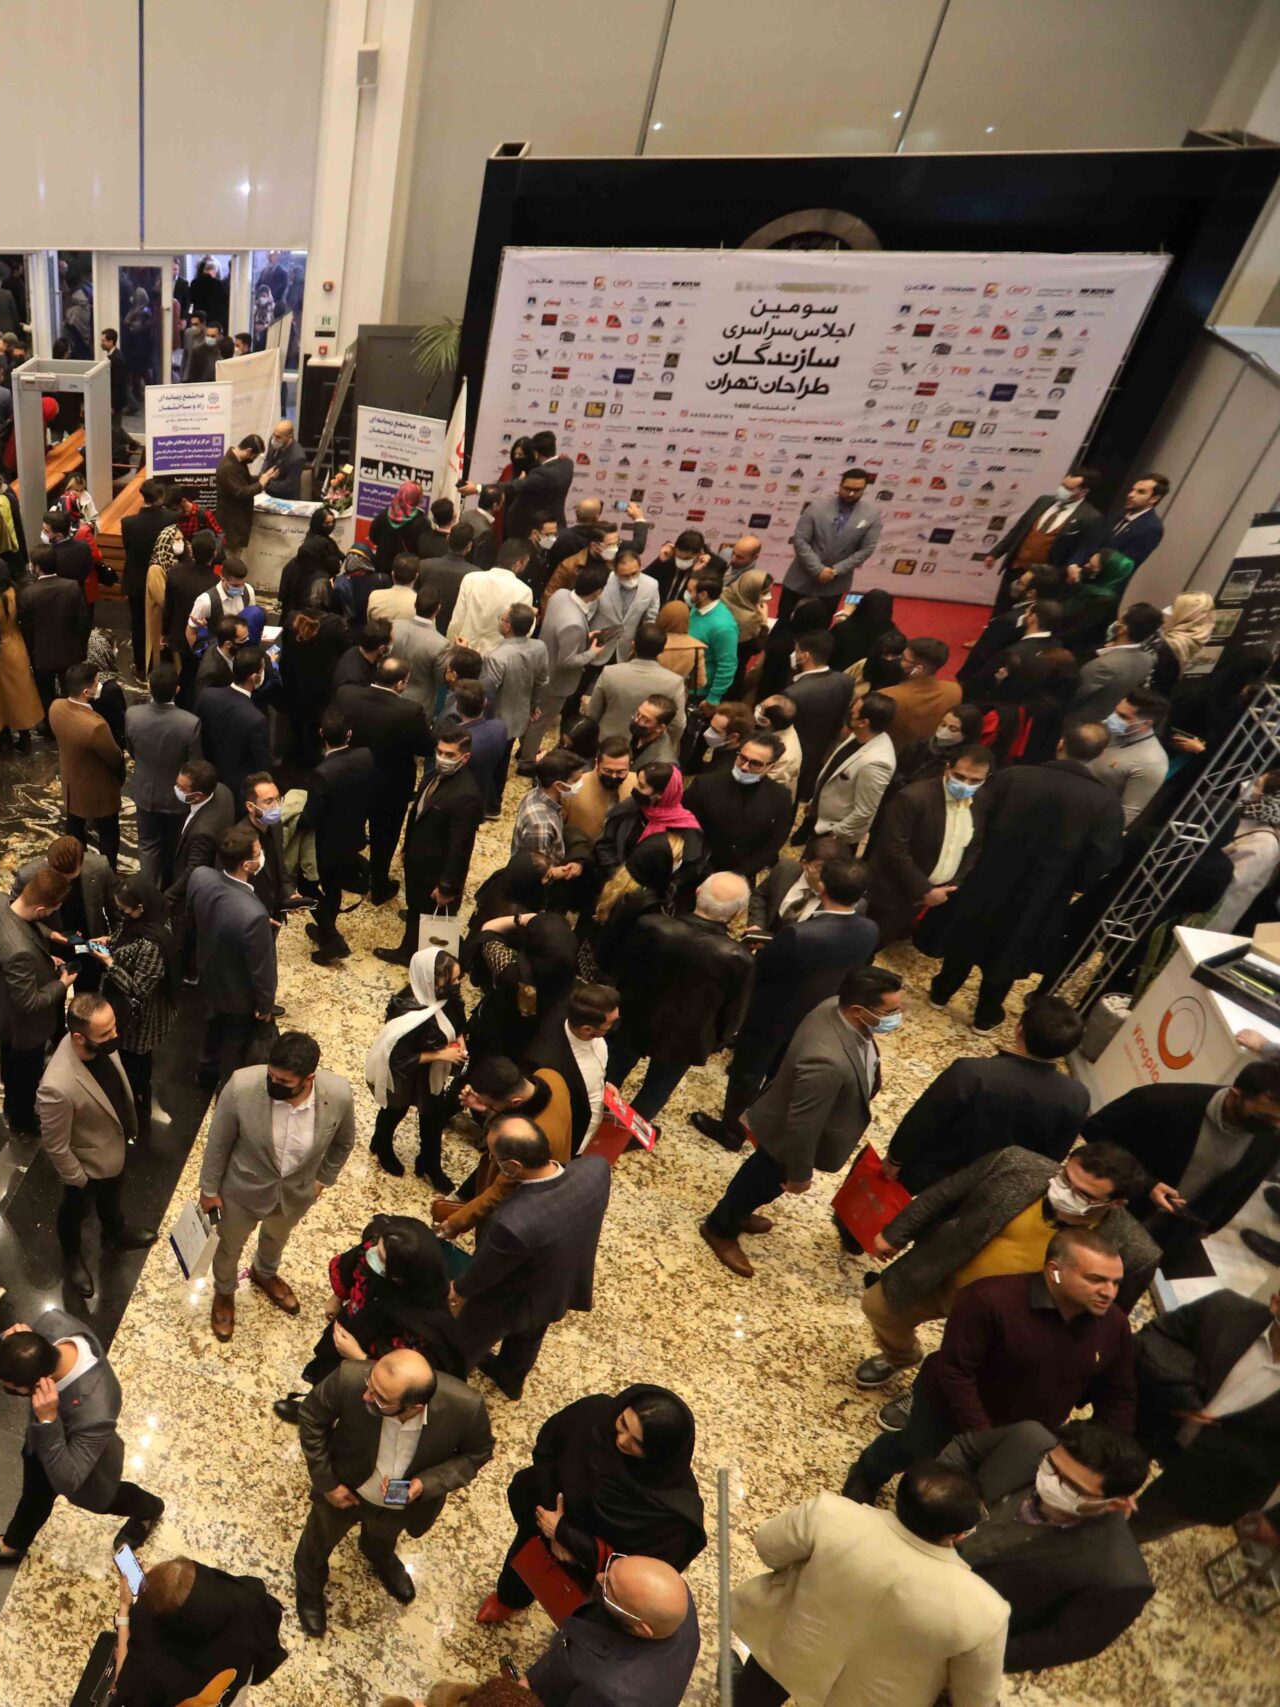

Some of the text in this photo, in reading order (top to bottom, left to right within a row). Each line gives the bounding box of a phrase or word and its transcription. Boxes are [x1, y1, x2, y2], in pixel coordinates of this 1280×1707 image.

[751, 299, 838, 319] سومین
[722, 320, 855, 343] اجلاس سراسری
[713, 340, 840, 373] سازندگان
[705, 373, 830, 399] طراحان تهران
